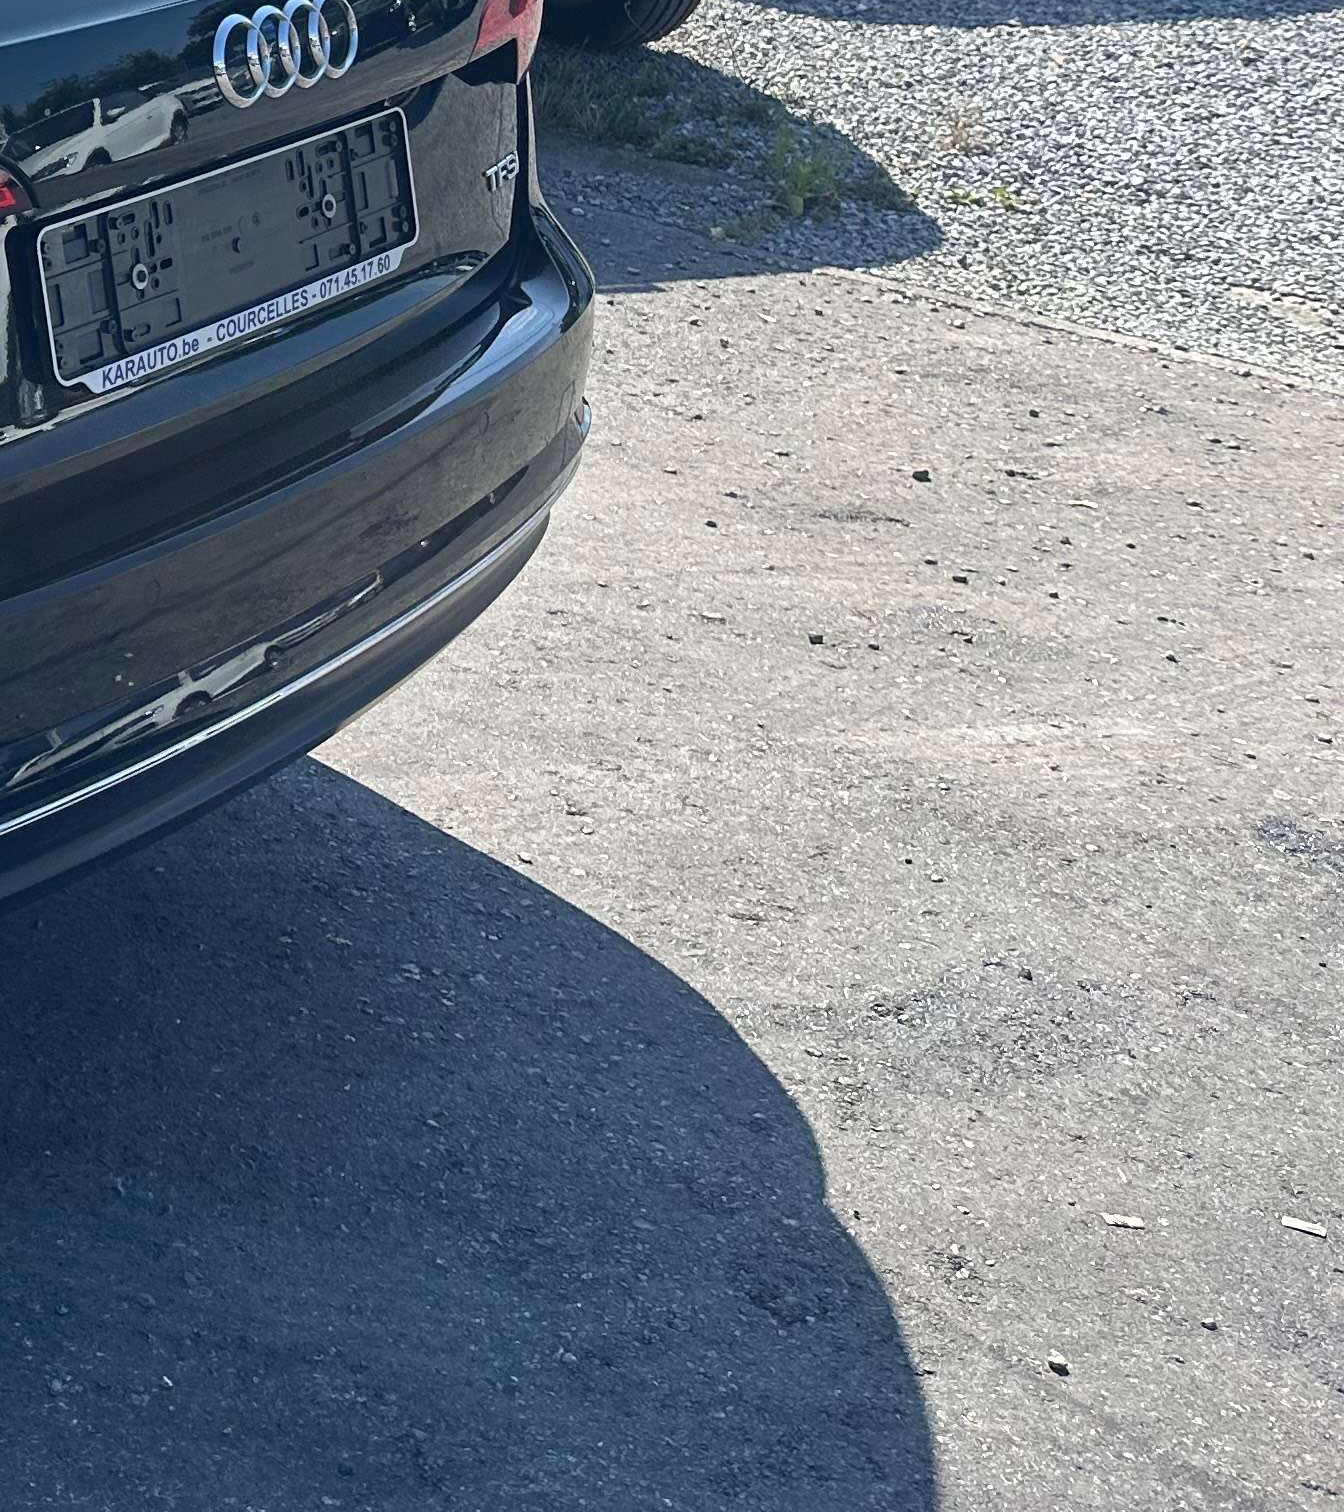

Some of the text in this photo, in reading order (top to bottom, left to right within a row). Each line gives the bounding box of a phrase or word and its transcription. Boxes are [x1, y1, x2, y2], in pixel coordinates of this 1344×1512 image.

[102, 338, 200, 388] KARAUTO.be
[216, 289, 309, 341] COURCELLES
[320, 254, 391, 298] 071.45.17.60
